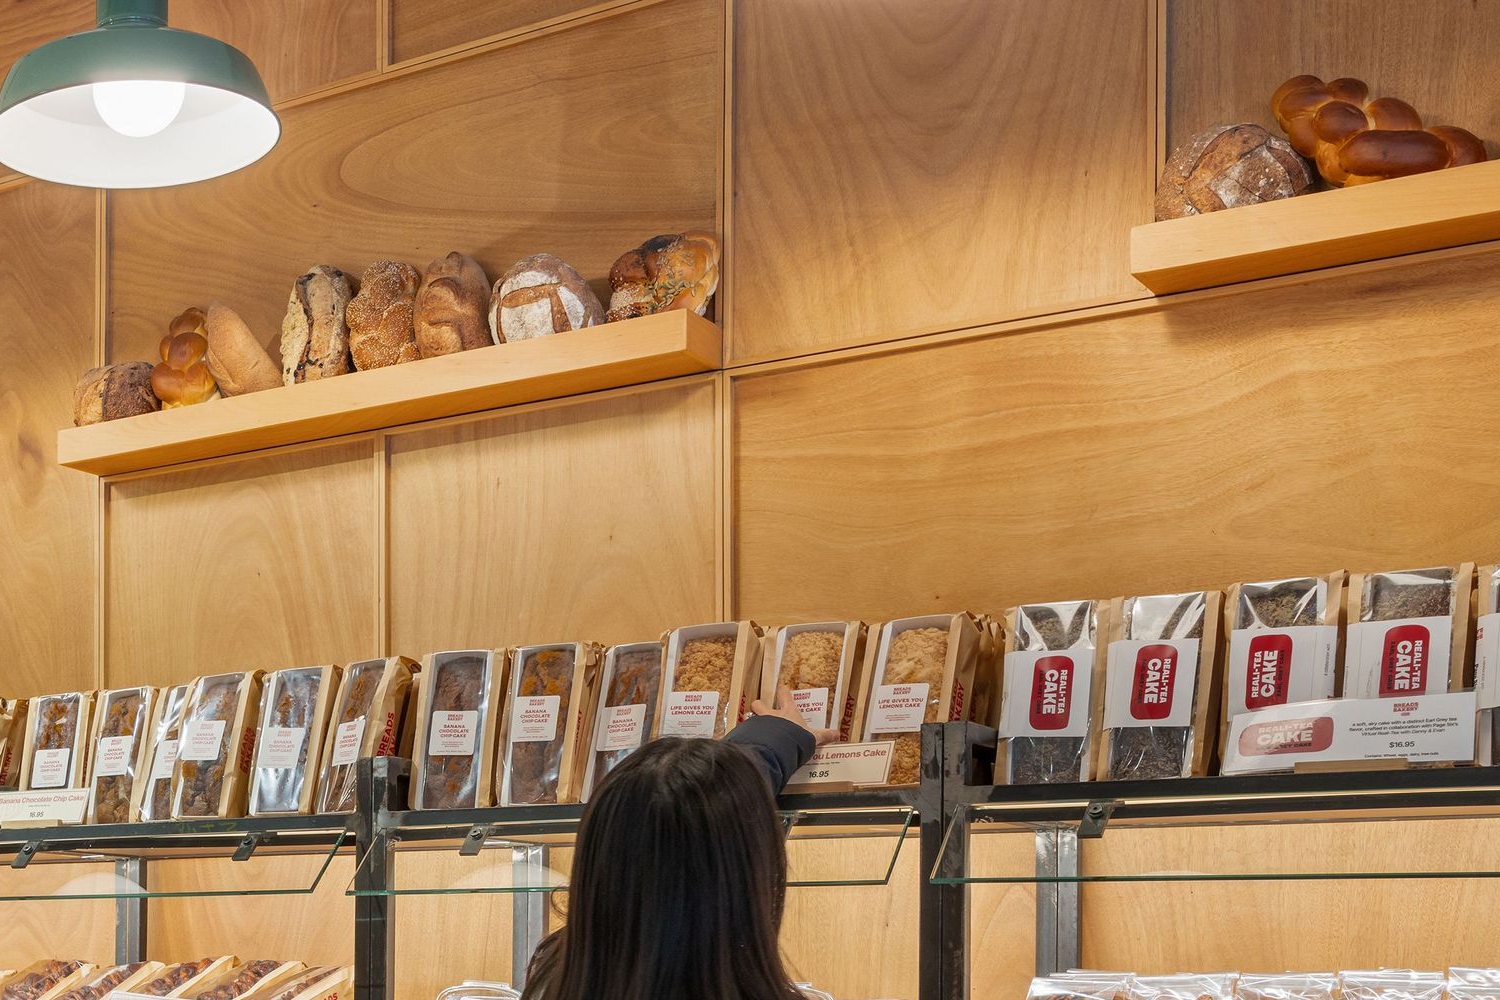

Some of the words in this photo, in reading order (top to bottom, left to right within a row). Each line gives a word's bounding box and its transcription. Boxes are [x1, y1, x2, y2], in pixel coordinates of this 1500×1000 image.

[1143, 658, 1162, 704] CAKE
[1159, 659, 1171, 704] REALI-TEA
[1251, 651, 1262, 698] REALI-TEA
[1261, 650, 1278, 697] CAKE
[1394, 641, 1413, 690] CAKE
[1411, 640, 1422, 689] REALI-TEA
[1042, 669, 1058, 714] CAKE
[1057, 670, 1068, 714] REALI-TEA
[840, 694, 855, 742] BAKERY
[1257, 730, 1313, 745] CAKE
[1260, 722, 1313, 734] REALI-TEA
[809, 770, 829, 778] 16.95
[826, 751, 860, 760] Lemons
[863, 749, 887, 757] Cake
